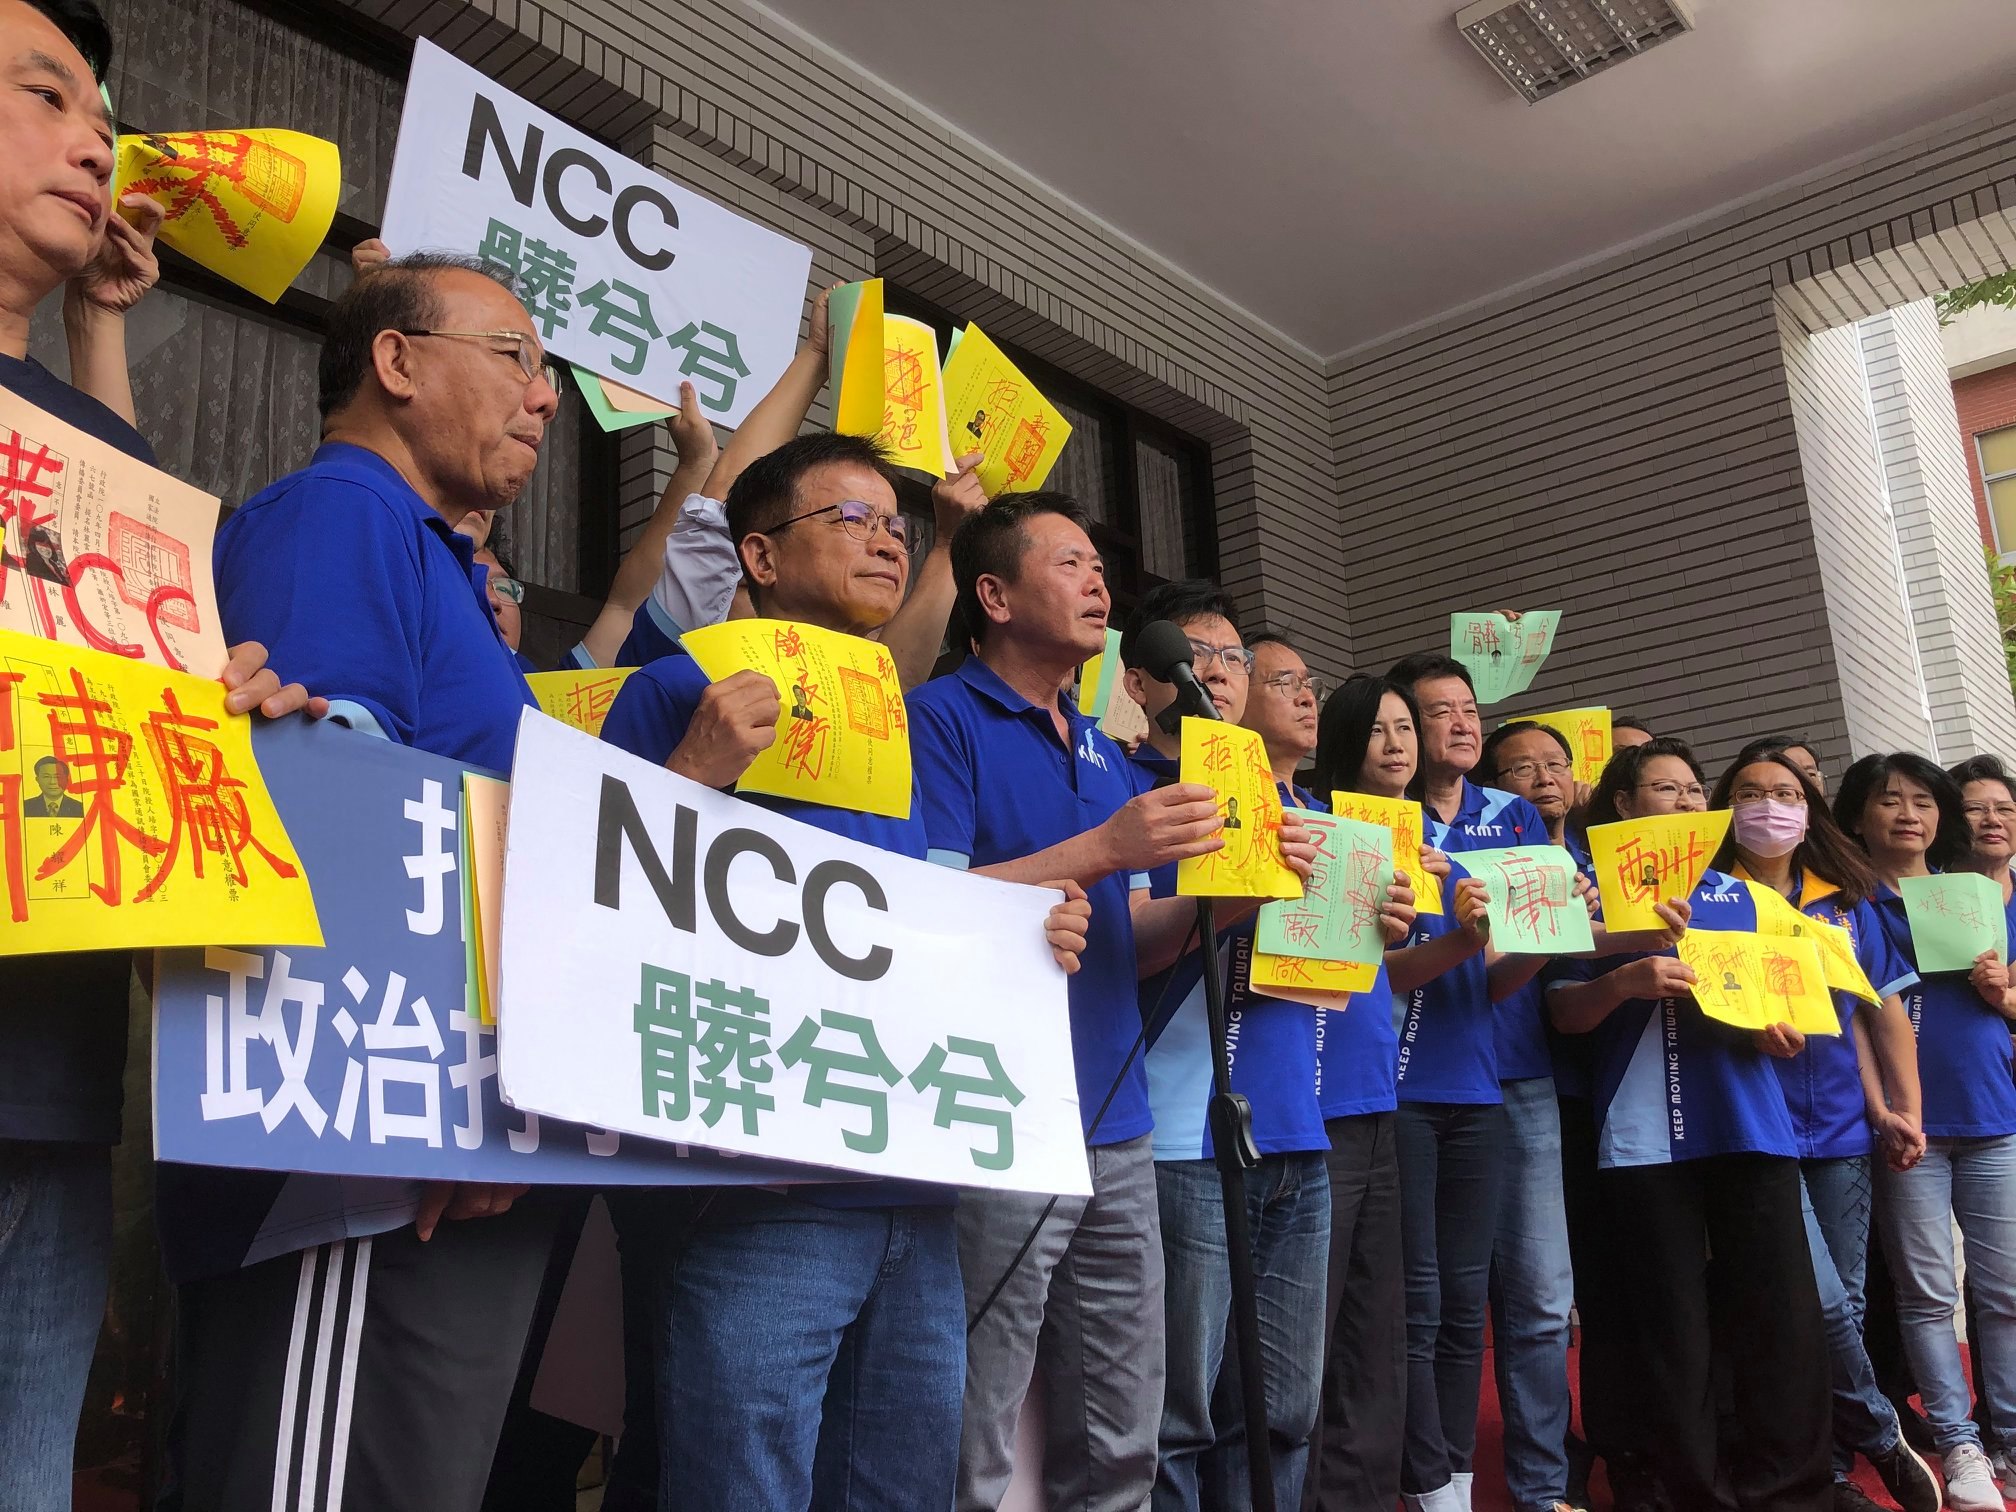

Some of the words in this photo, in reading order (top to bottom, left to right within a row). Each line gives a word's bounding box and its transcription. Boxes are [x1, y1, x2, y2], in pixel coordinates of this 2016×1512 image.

[462, 92, 679, 271] NCC
[1464, 824, 1502, 837] KMT
[594, 773, 893, 981] NCC
[1701, 890, 1740, 903] KMT
[1231, 936, 1249, 1004] TAIWAN
[1397, 1046, 1411, 1081] KEEP
[1406, 989, 1424, 1043] MOVING
[1667, 997, 1678, 1048] TAIWAN
[633, 962, 1026, 1171] 髒兮兮
[1669, 1053, 1682, 1104] MOVING
[1674, 1107, 1685, 1141] KEEP
